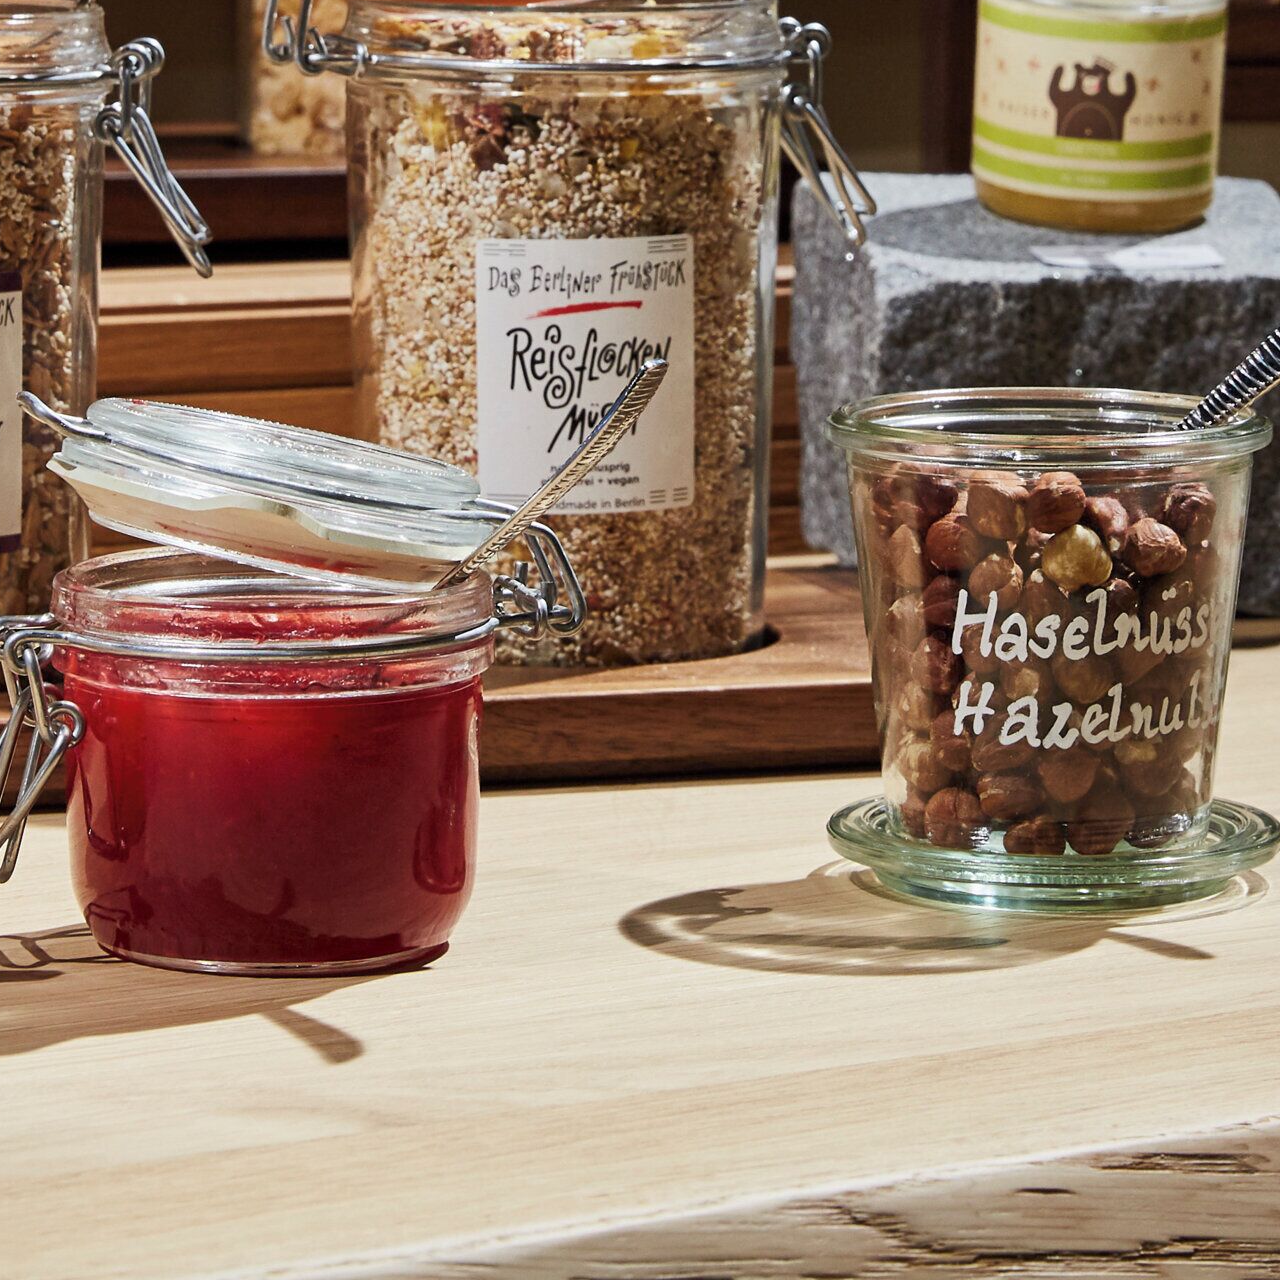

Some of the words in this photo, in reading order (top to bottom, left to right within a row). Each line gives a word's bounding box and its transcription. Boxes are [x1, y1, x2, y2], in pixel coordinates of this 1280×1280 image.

[607, 476, 640, 487] vegan
[601, 499, 611, 508] in
[615, 497, 646, 508] Berlin
